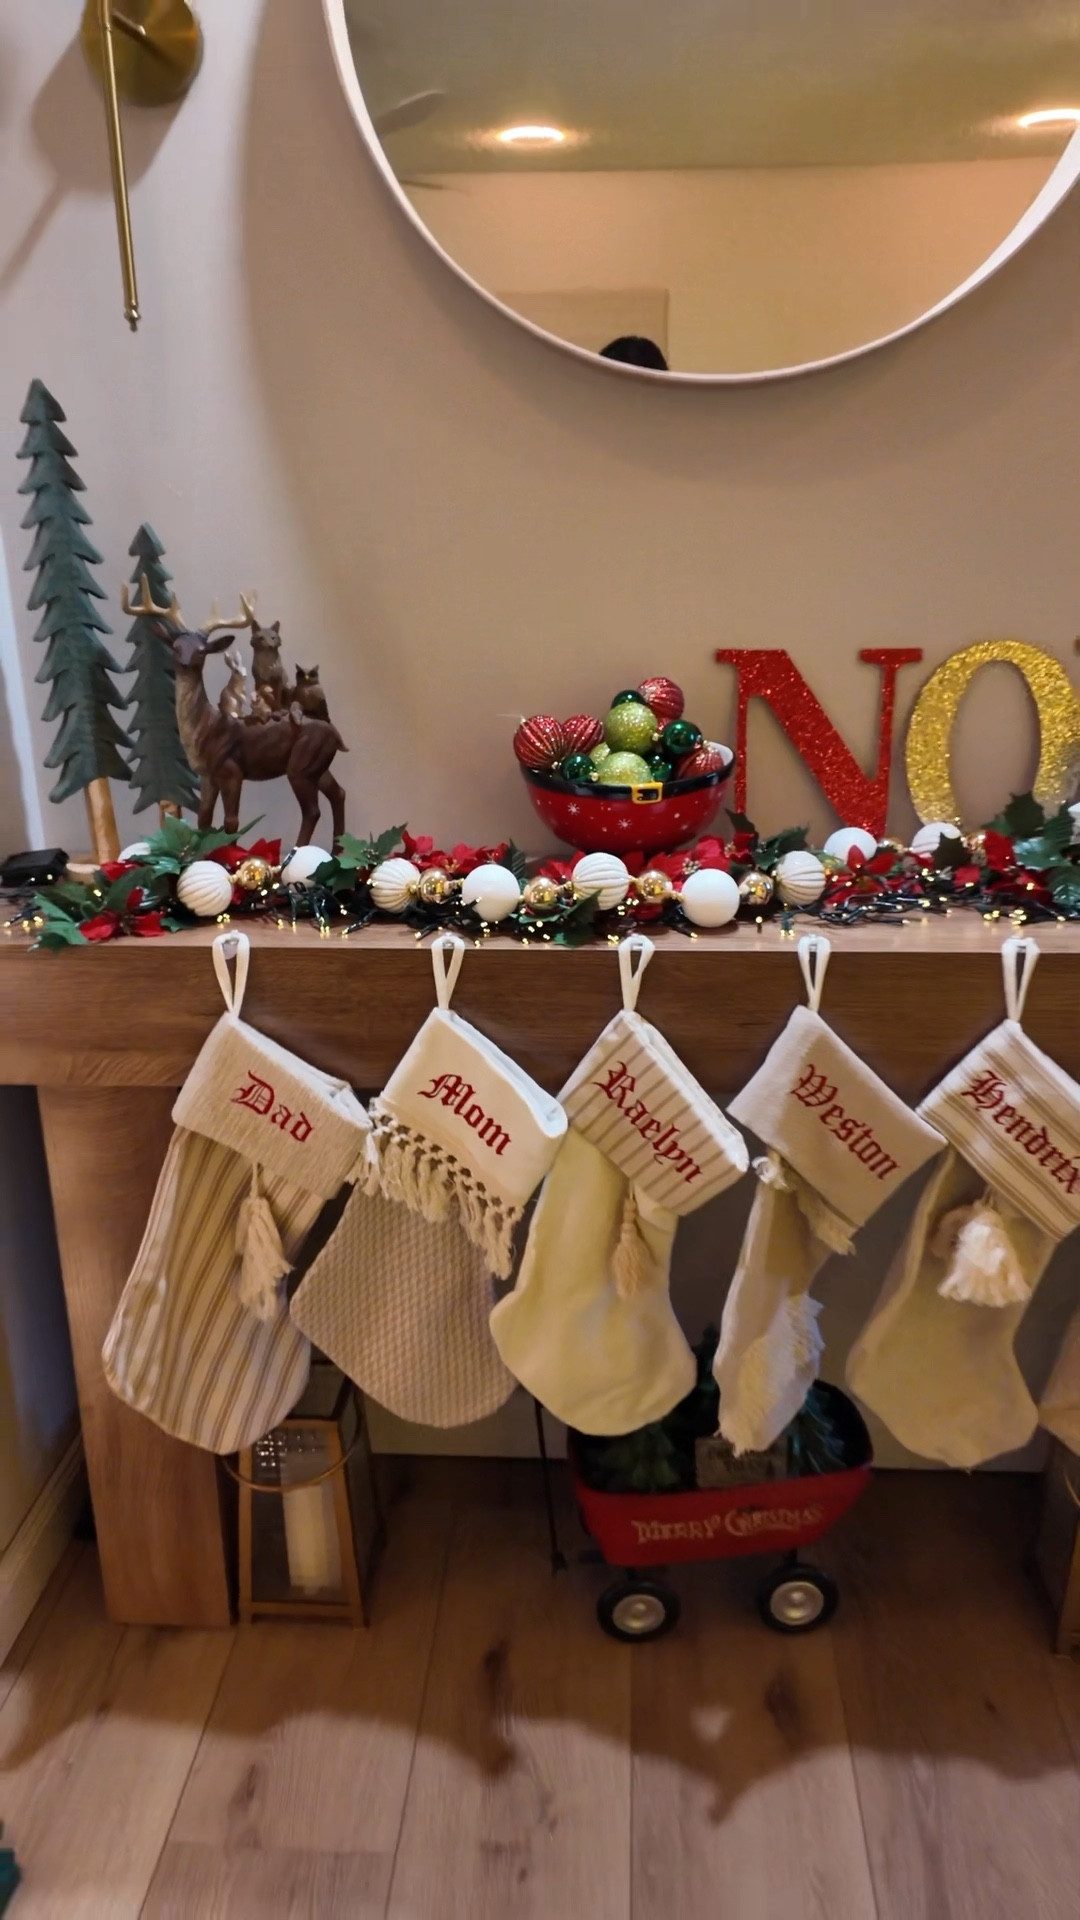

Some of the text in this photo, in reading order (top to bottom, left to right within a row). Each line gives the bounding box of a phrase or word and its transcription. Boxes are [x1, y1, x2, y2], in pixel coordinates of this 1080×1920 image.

[715, 640, 1080, 842] NO
[231, 1070, 314, 1142] Dad
[418, 1073, 511, 1155] Mom
[593, 1061, 703, 1183] Raelyn
[791, 1064, 899, 1180] Weston
